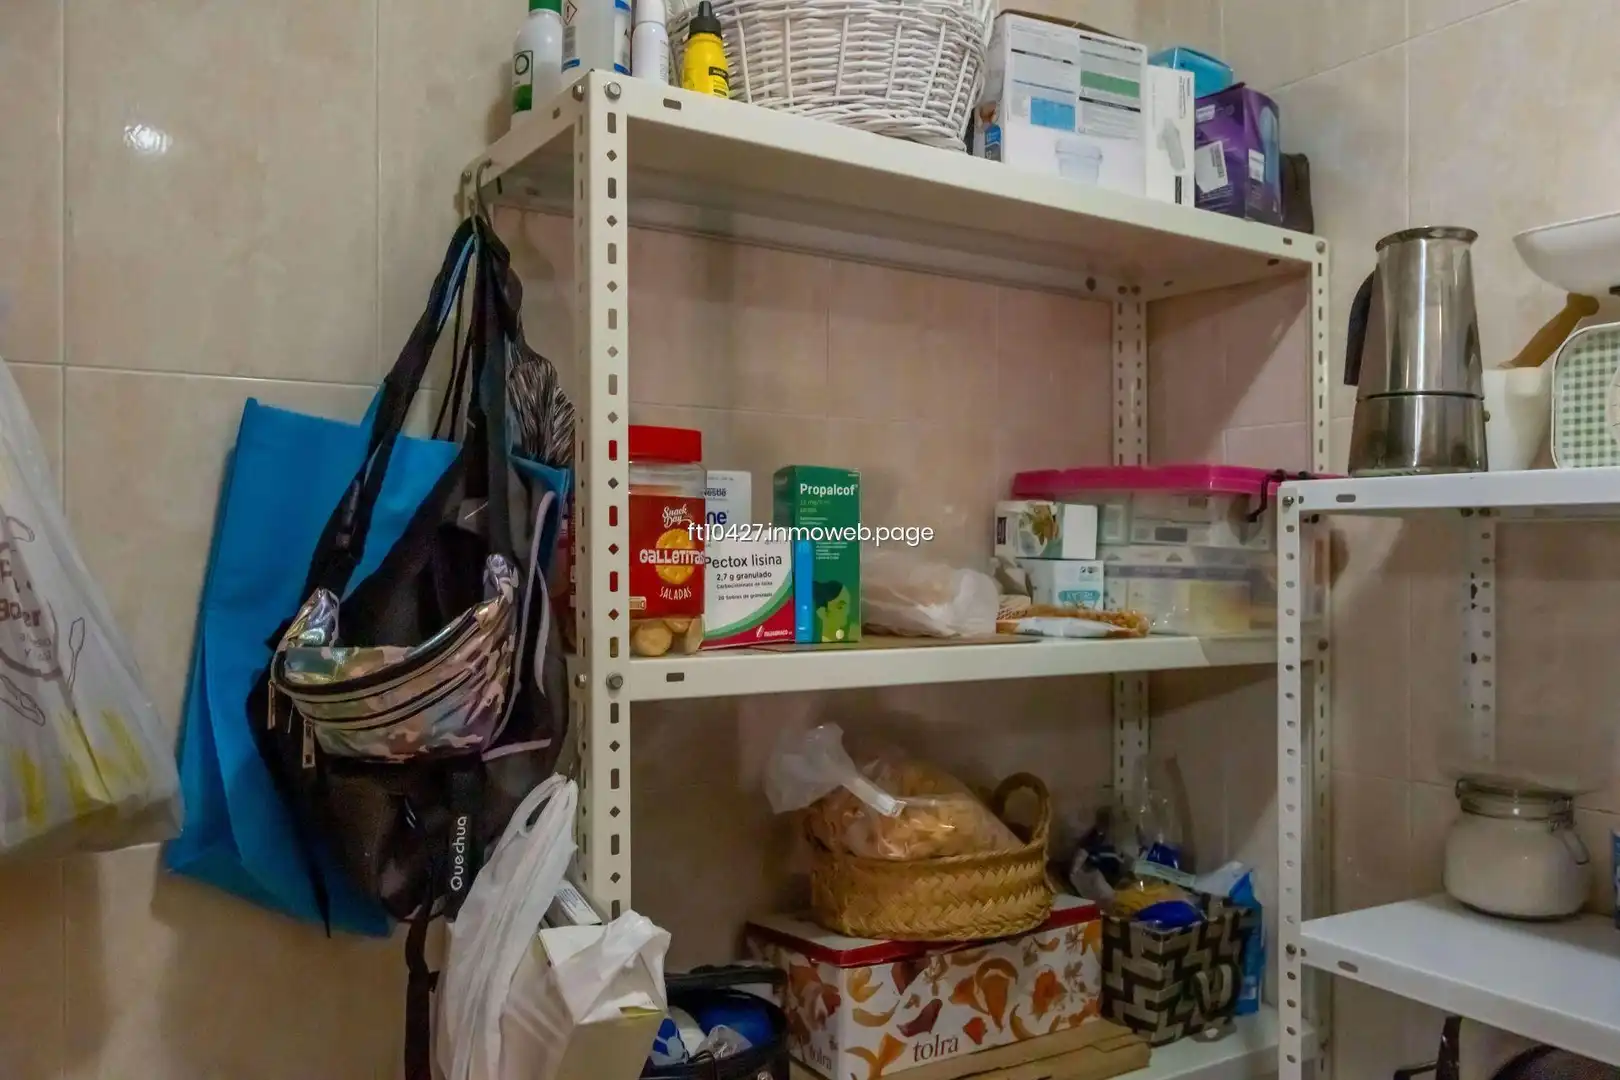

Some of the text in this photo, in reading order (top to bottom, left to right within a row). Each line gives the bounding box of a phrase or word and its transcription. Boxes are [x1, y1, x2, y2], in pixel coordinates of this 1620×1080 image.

[800, 483, 856, 498] Propalcof
[662, 503, 688, 519] Snack
[664, 515, 692, 529] Day
[704, 553, 783, 569] Pectox lisina
[736, 570, 773, 581] granulado
[658, 585, 693, 601] SALADAS
[450, 815, 468, 891] Quechua
[913, 1033, 959, 1063] tolra
[809, 1043, 833, 1070] tolra
